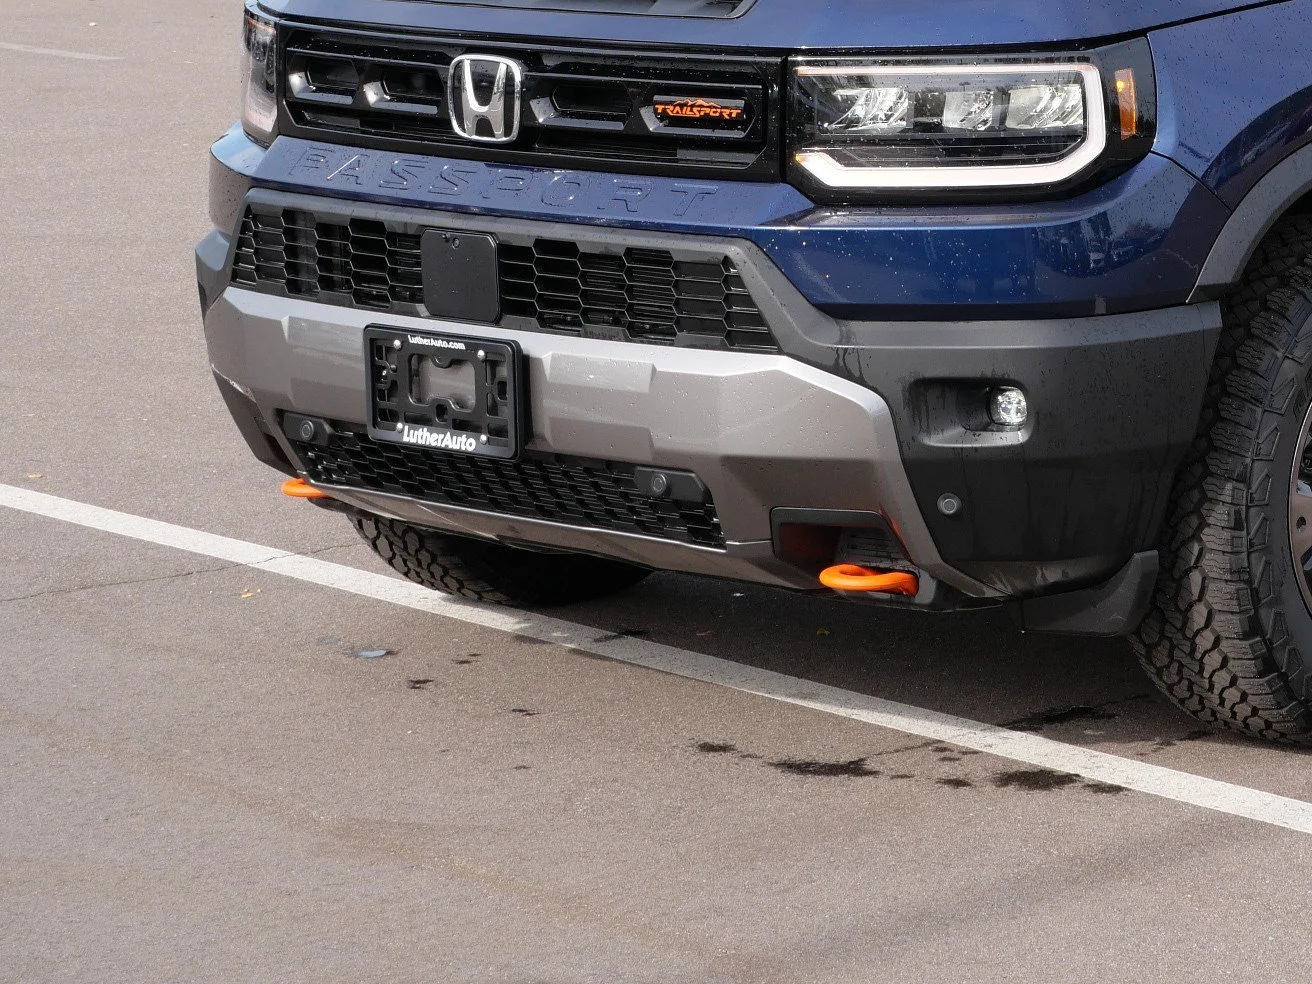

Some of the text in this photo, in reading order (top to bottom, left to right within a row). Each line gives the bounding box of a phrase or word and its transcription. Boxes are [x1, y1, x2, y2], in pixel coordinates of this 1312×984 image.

[655, 105, 741, 119] TRAILSPORT
[289, 147, 720, 216] PASSPORT
[408, 334, 466, 350] LutherAuto.com
[403, 425, 477, 452] LutherAuto
